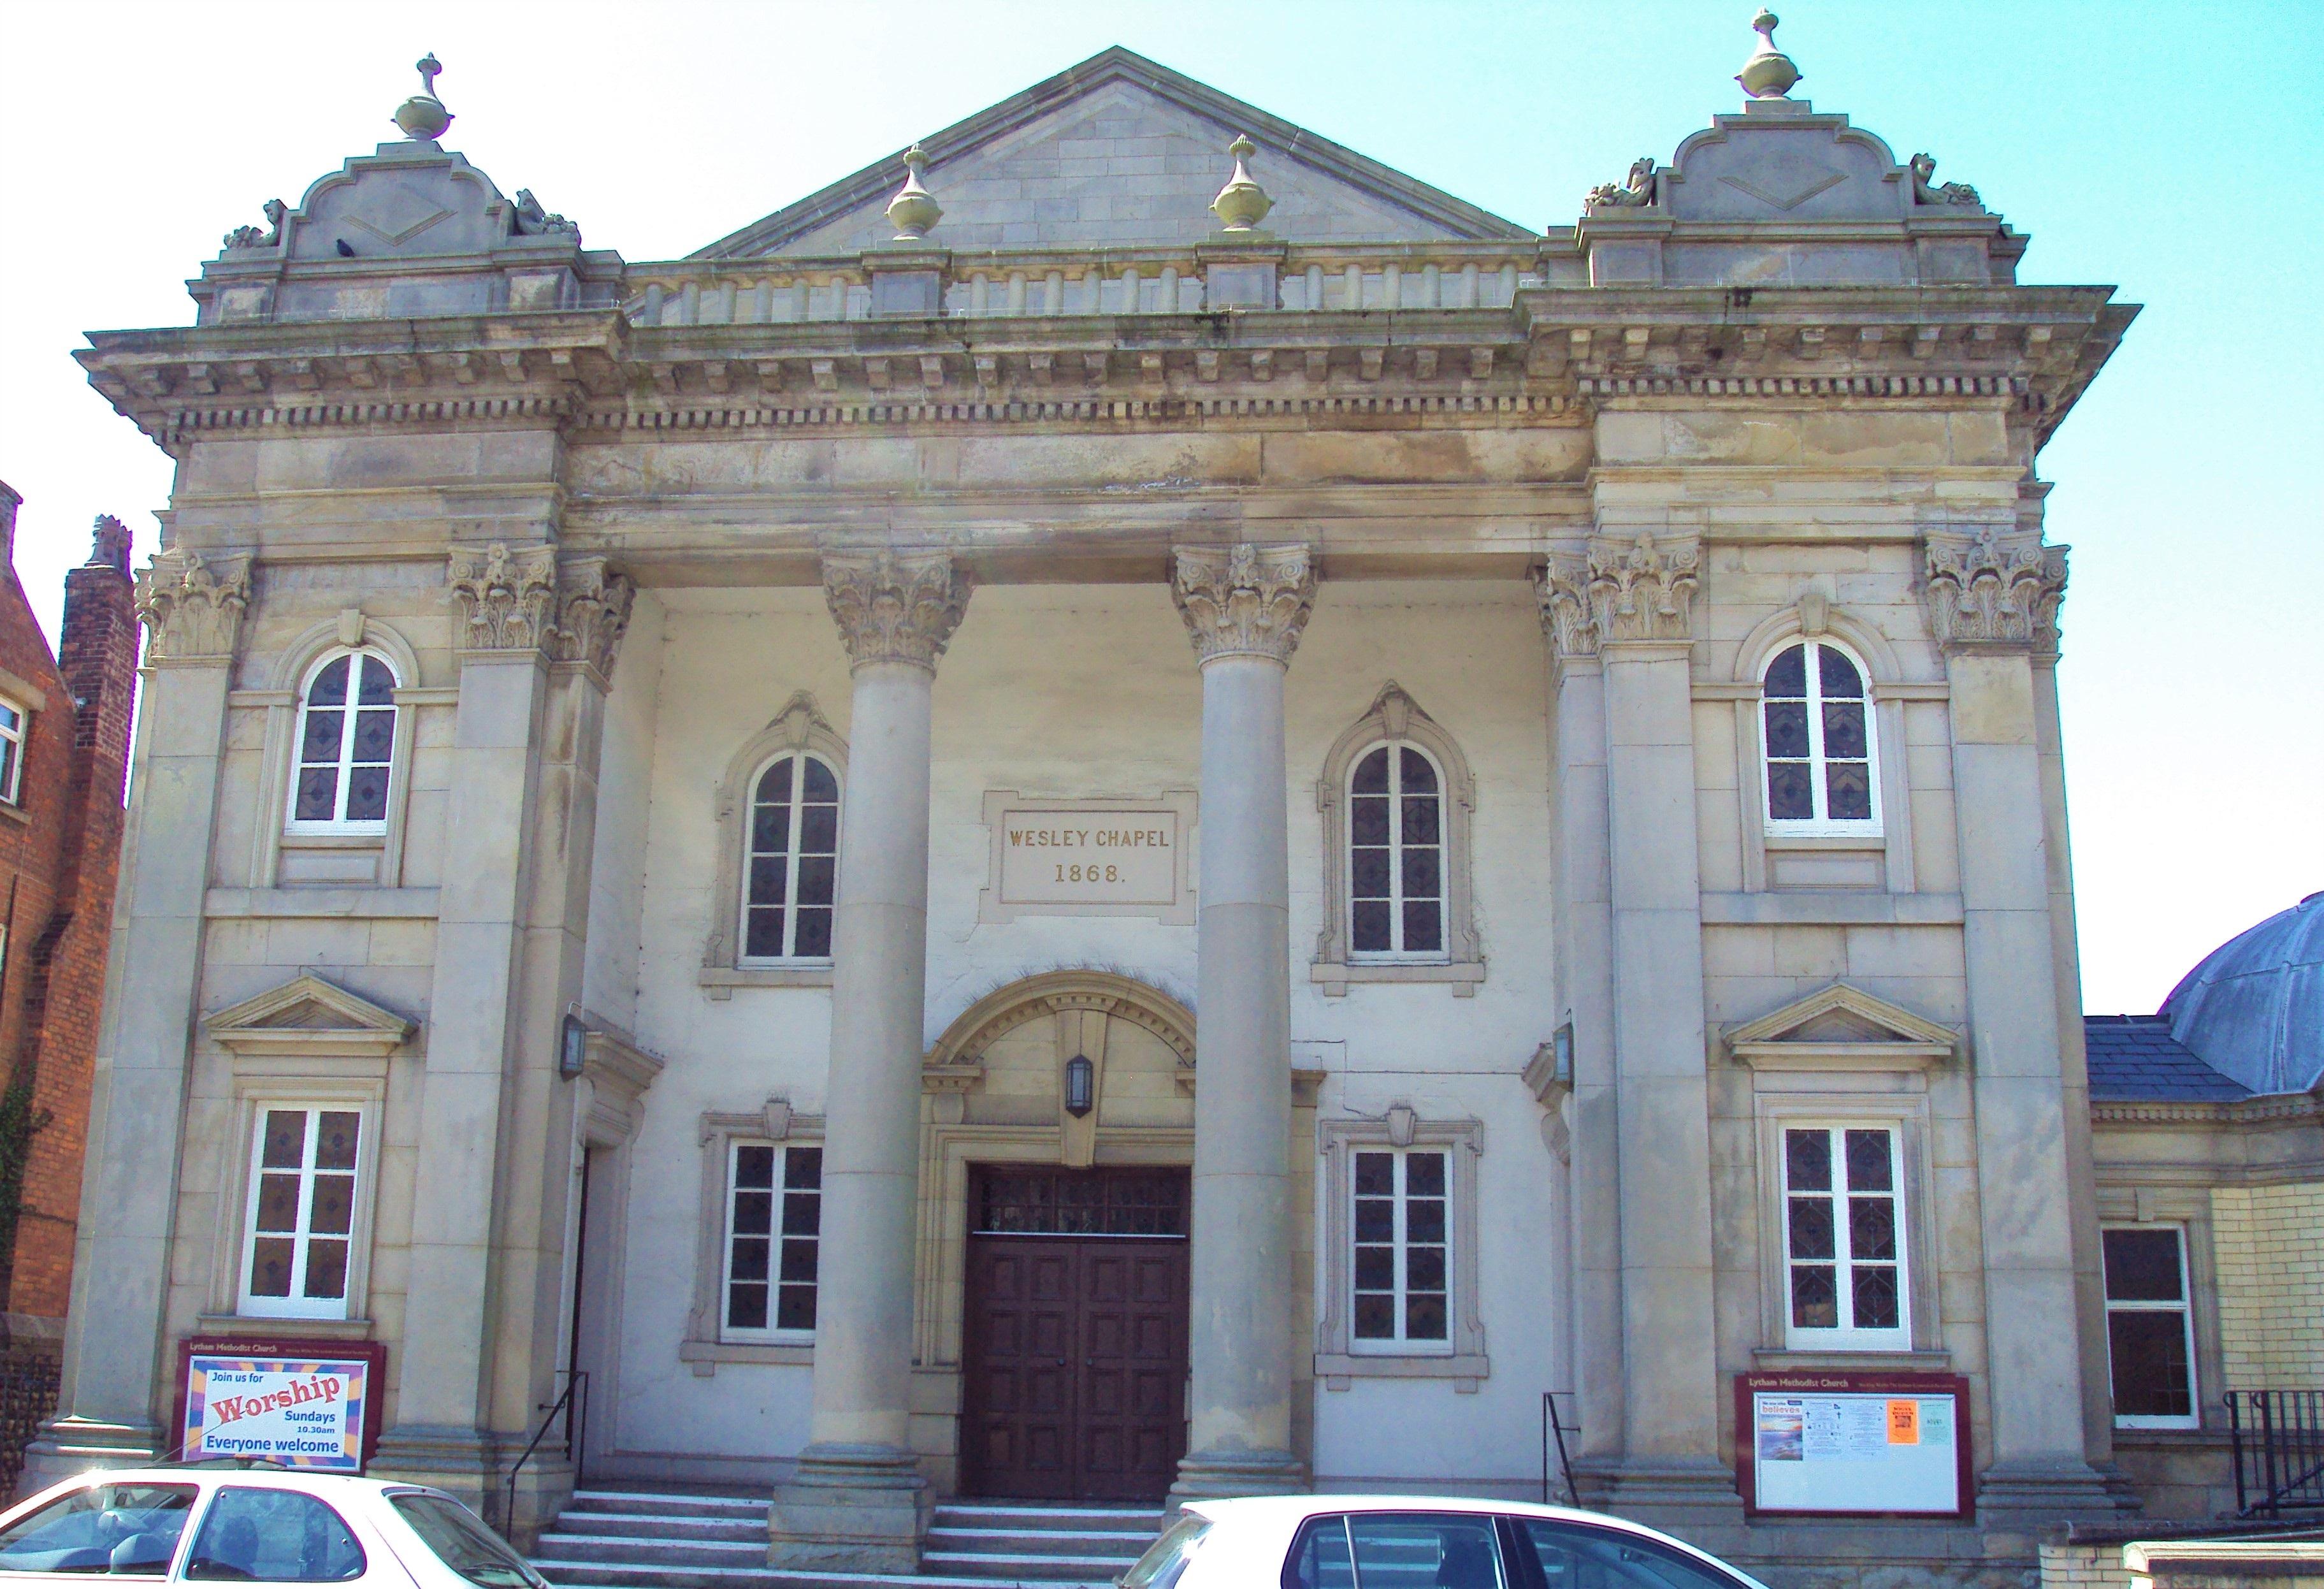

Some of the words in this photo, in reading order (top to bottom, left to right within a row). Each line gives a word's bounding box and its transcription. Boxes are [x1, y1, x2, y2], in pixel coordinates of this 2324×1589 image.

[1009, 831, 1089, 847] WESLEY
[1095, 831, 1169, 847] CHAPEL
[1055, 864, 1126, 883] 1868.
[189, 1342, 215, 1351] Lytham
[216, 1343, 251, 1352] Methodist
[252, 1344, 277, 1353] Church
[212, 1372, 232, 1382] Join
[235, 1374, 247, 1383] us
[249, 1373, 264, 1384] for
[1749, 1378, 1777, 1388] Lytham
[1779, 1379, 1819, 1388] Methodist
[1821, 1379, 1849, 1388] Church
[211, 1375, 340, 1425] Worship
[284, 1411, 336, 1425] Sundays
[297, 1426, 335, 1434] 10.30am
[206, 1435, 271, 1452] Everyone
[275, 1438, 339, 1453] welcome
